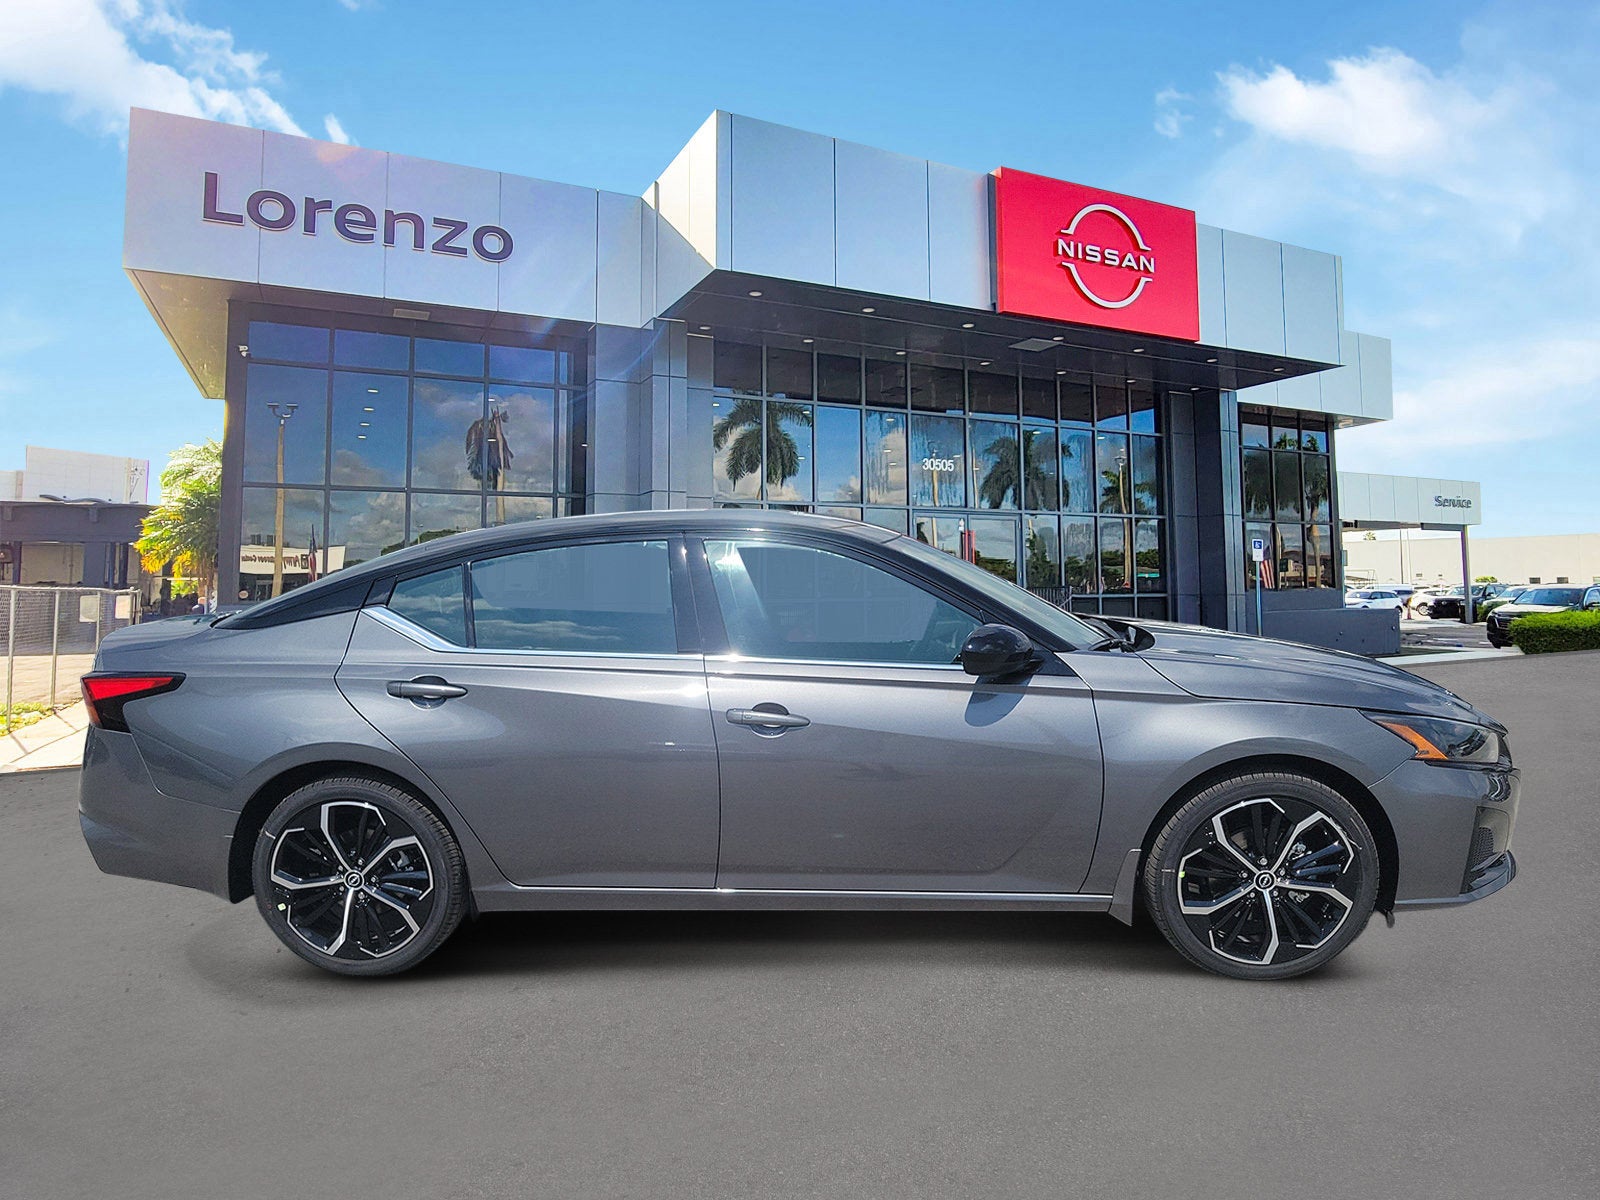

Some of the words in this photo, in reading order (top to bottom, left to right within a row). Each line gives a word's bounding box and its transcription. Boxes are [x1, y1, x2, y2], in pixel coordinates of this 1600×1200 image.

[203, 171, 514, 262] Lorenzo
[1058, 238, 1155, 273] NISSAN
[922, 458, 955, 471] 30505
[1434, 495, 1472, 508] Service
